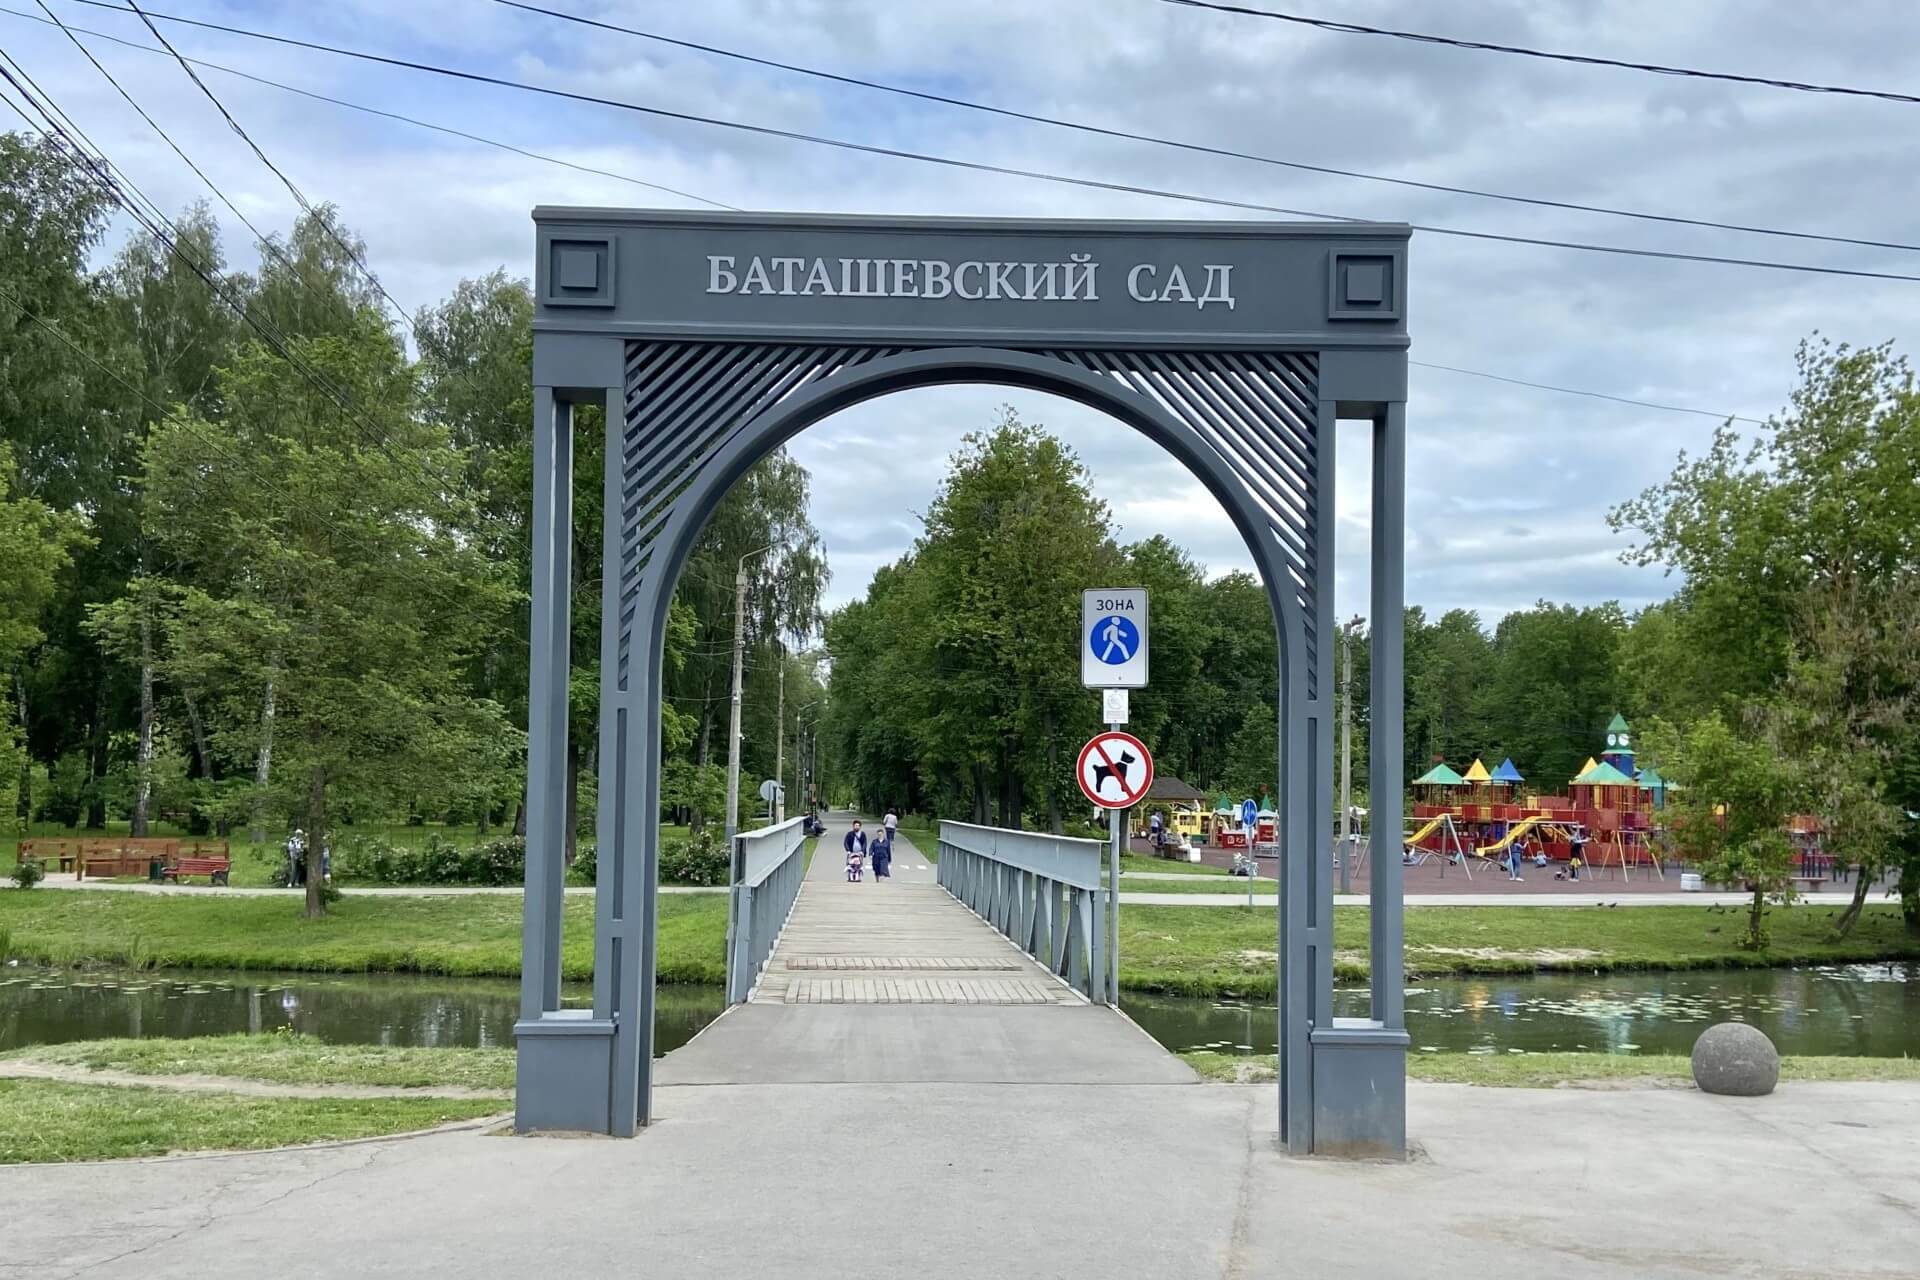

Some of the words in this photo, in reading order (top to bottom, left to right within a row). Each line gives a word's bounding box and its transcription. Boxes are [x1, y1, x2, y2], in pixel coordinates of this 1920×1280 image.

[705, 253, 1099, 301] БАТАШЕВСКИЙ
[1126, 264, 1235, 310] САД
[1096, 599, 1135, 611] ЗОНА
